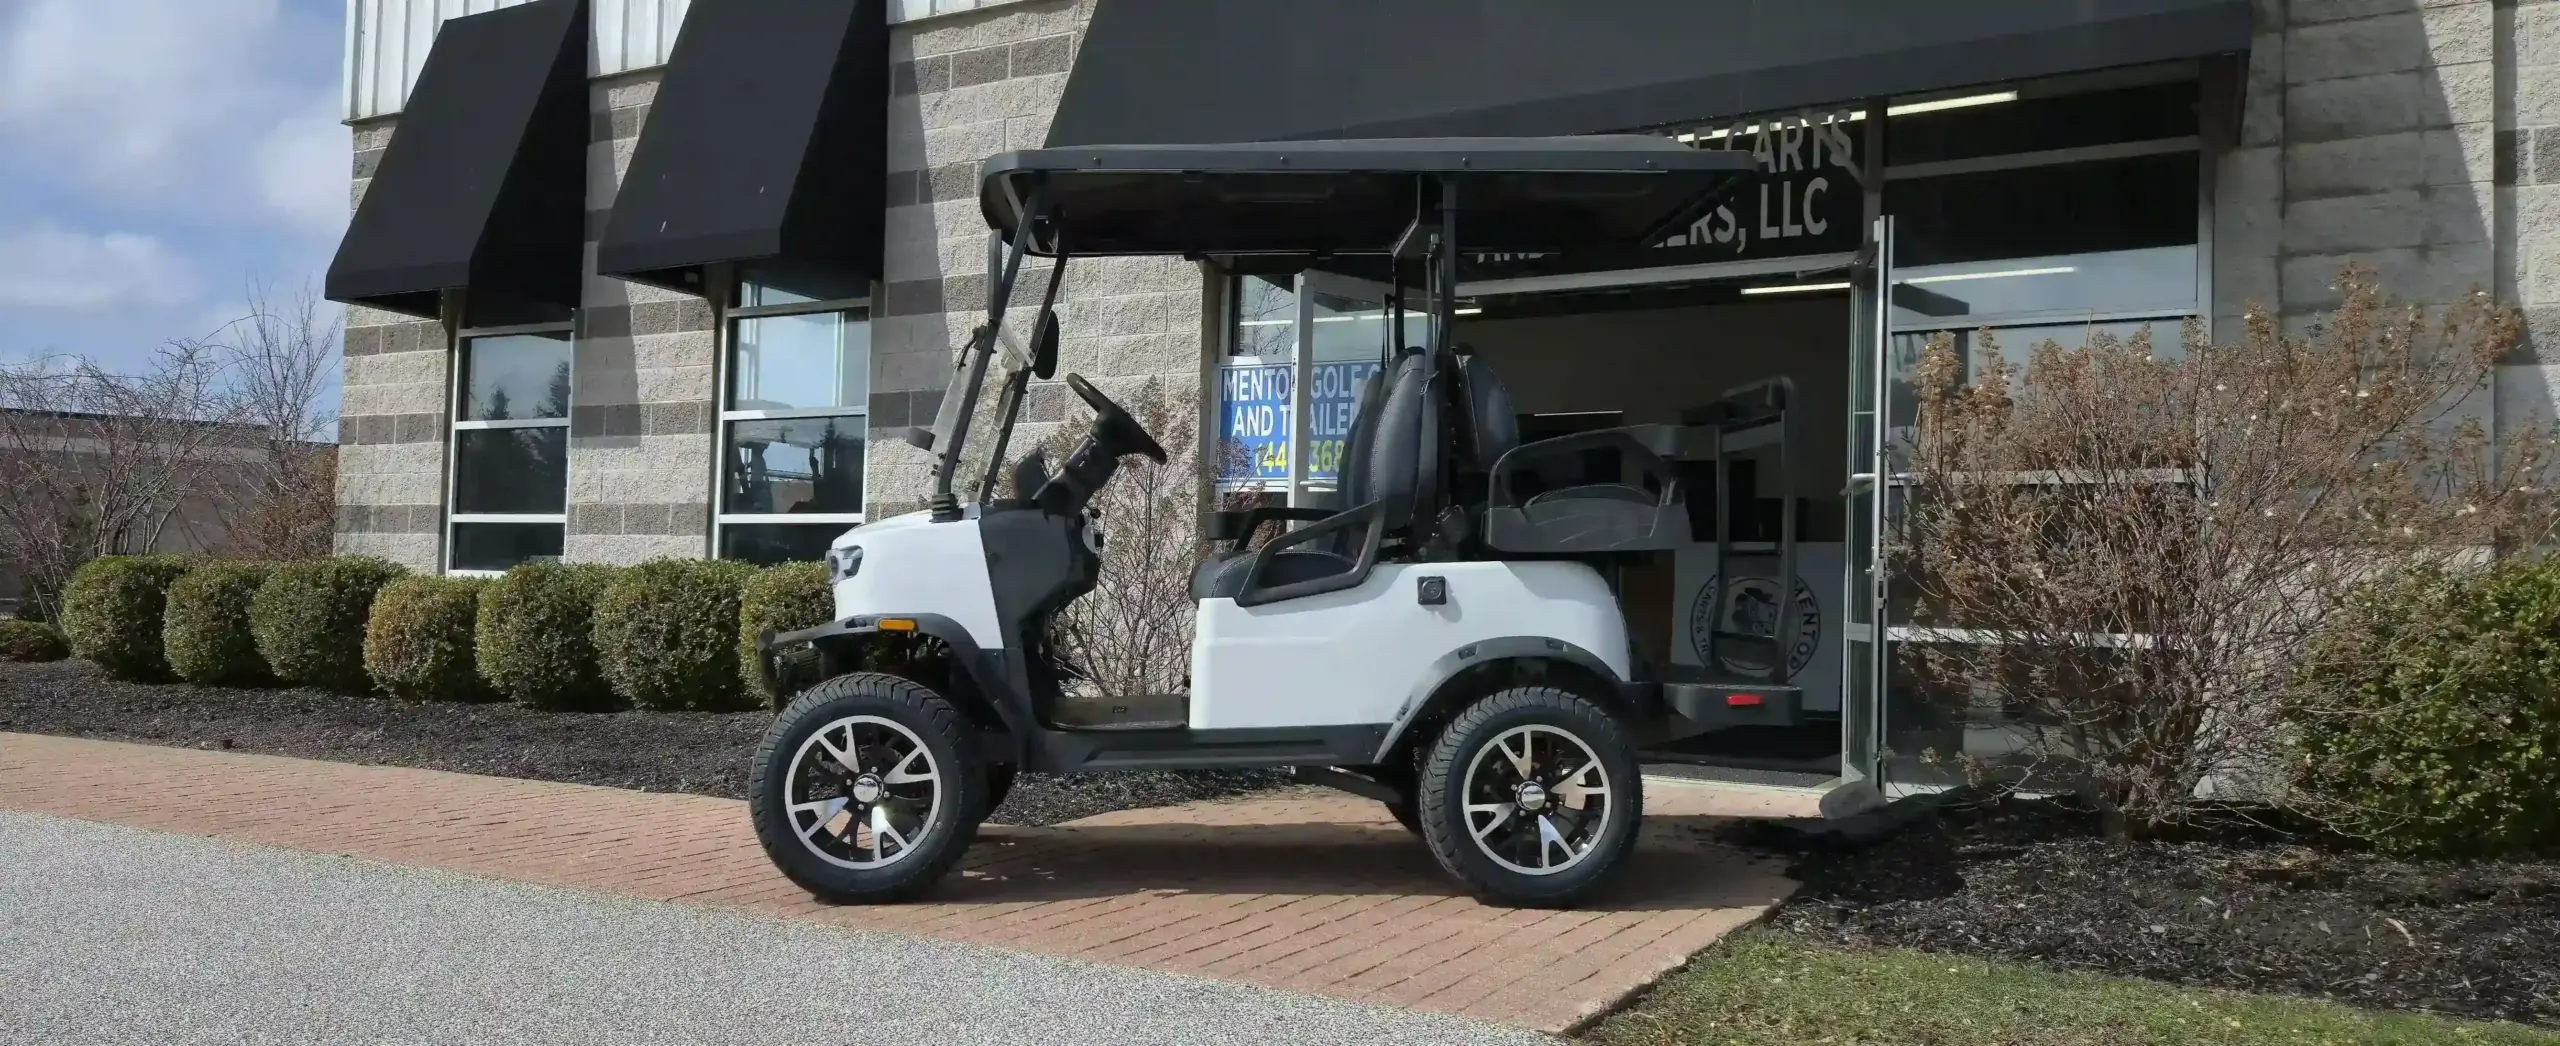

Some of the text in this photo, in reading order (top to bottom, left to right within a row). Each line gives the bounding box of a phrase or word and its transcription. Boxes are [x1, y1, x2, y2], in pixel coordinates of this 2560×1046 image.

[1760, 177, 1829, 239] LLC
[1223, 367, 1290, 402] MENTO
[1311, 364, 1362, 399] GOLF
[1232, 402, 1356, 437] AND TAILE
[1255, 439, 1345, 477] (44 368
